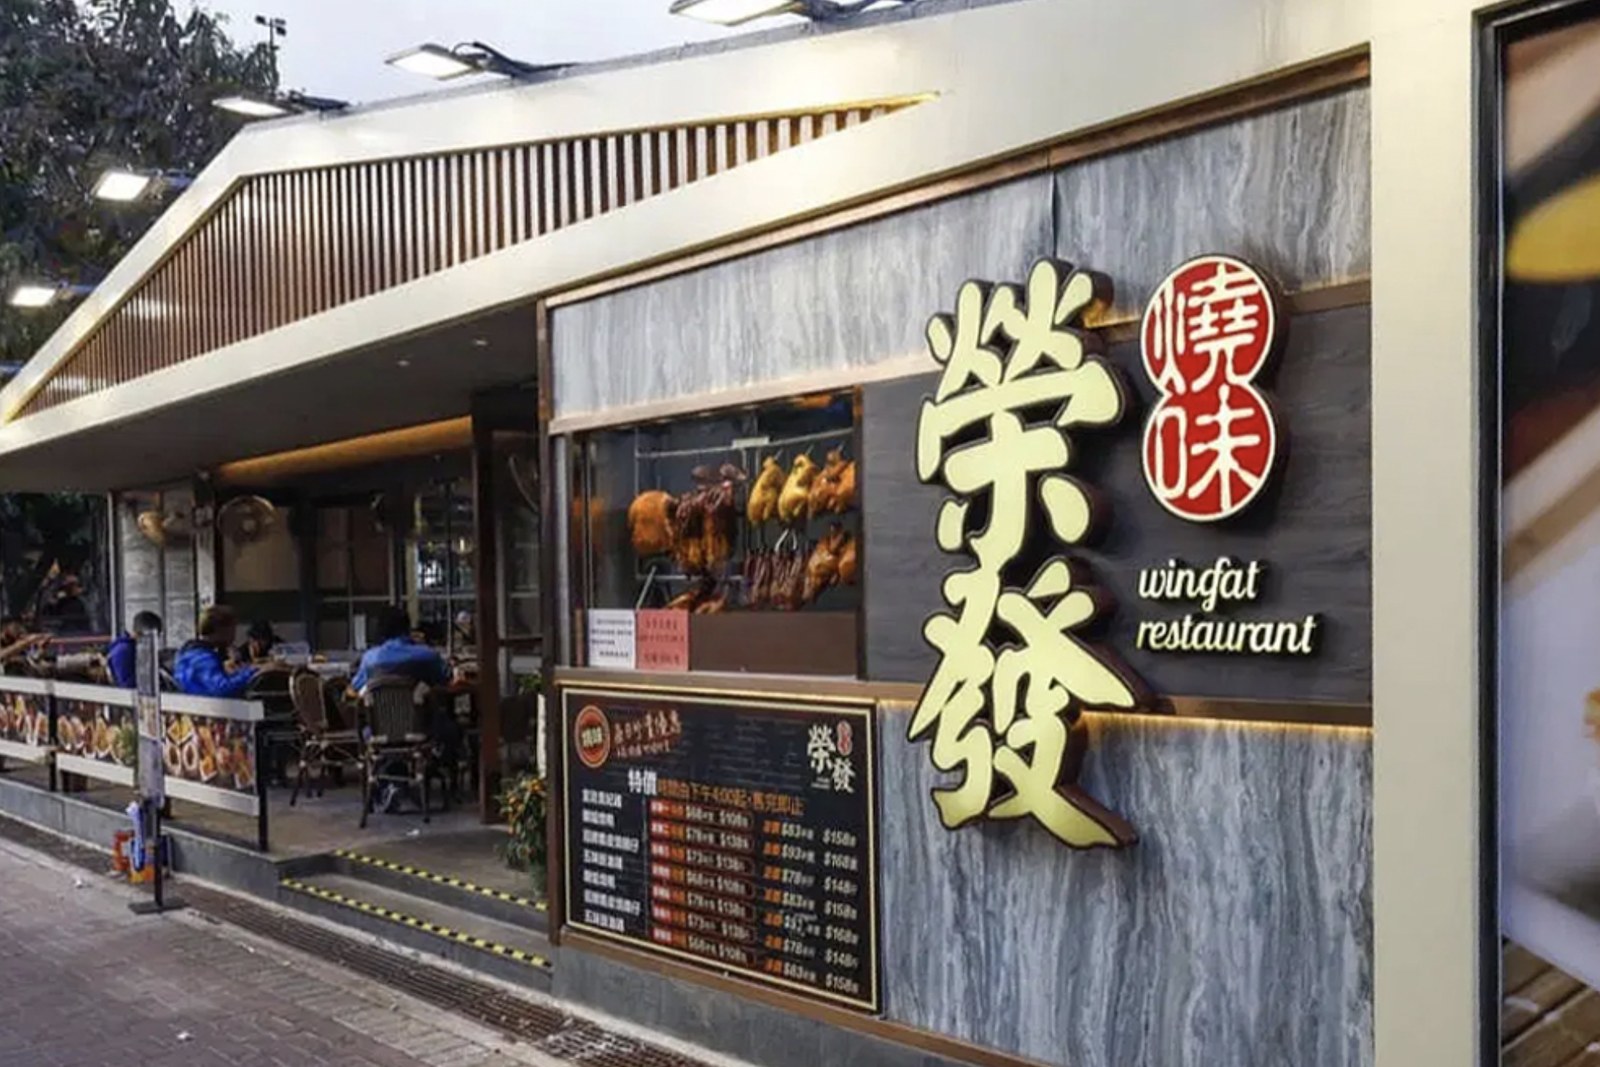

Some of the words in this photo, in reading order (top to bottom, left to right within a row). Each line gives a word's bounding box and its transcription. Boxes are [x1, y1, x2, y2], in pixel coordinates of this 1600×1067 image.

[1145, 259, 1272, 516] 燒味
[908, 259, 1136, 850] 榮發
[1138, 556, 1260, 612] wingfat
[1136, 614, 1316, 654] restaurant
